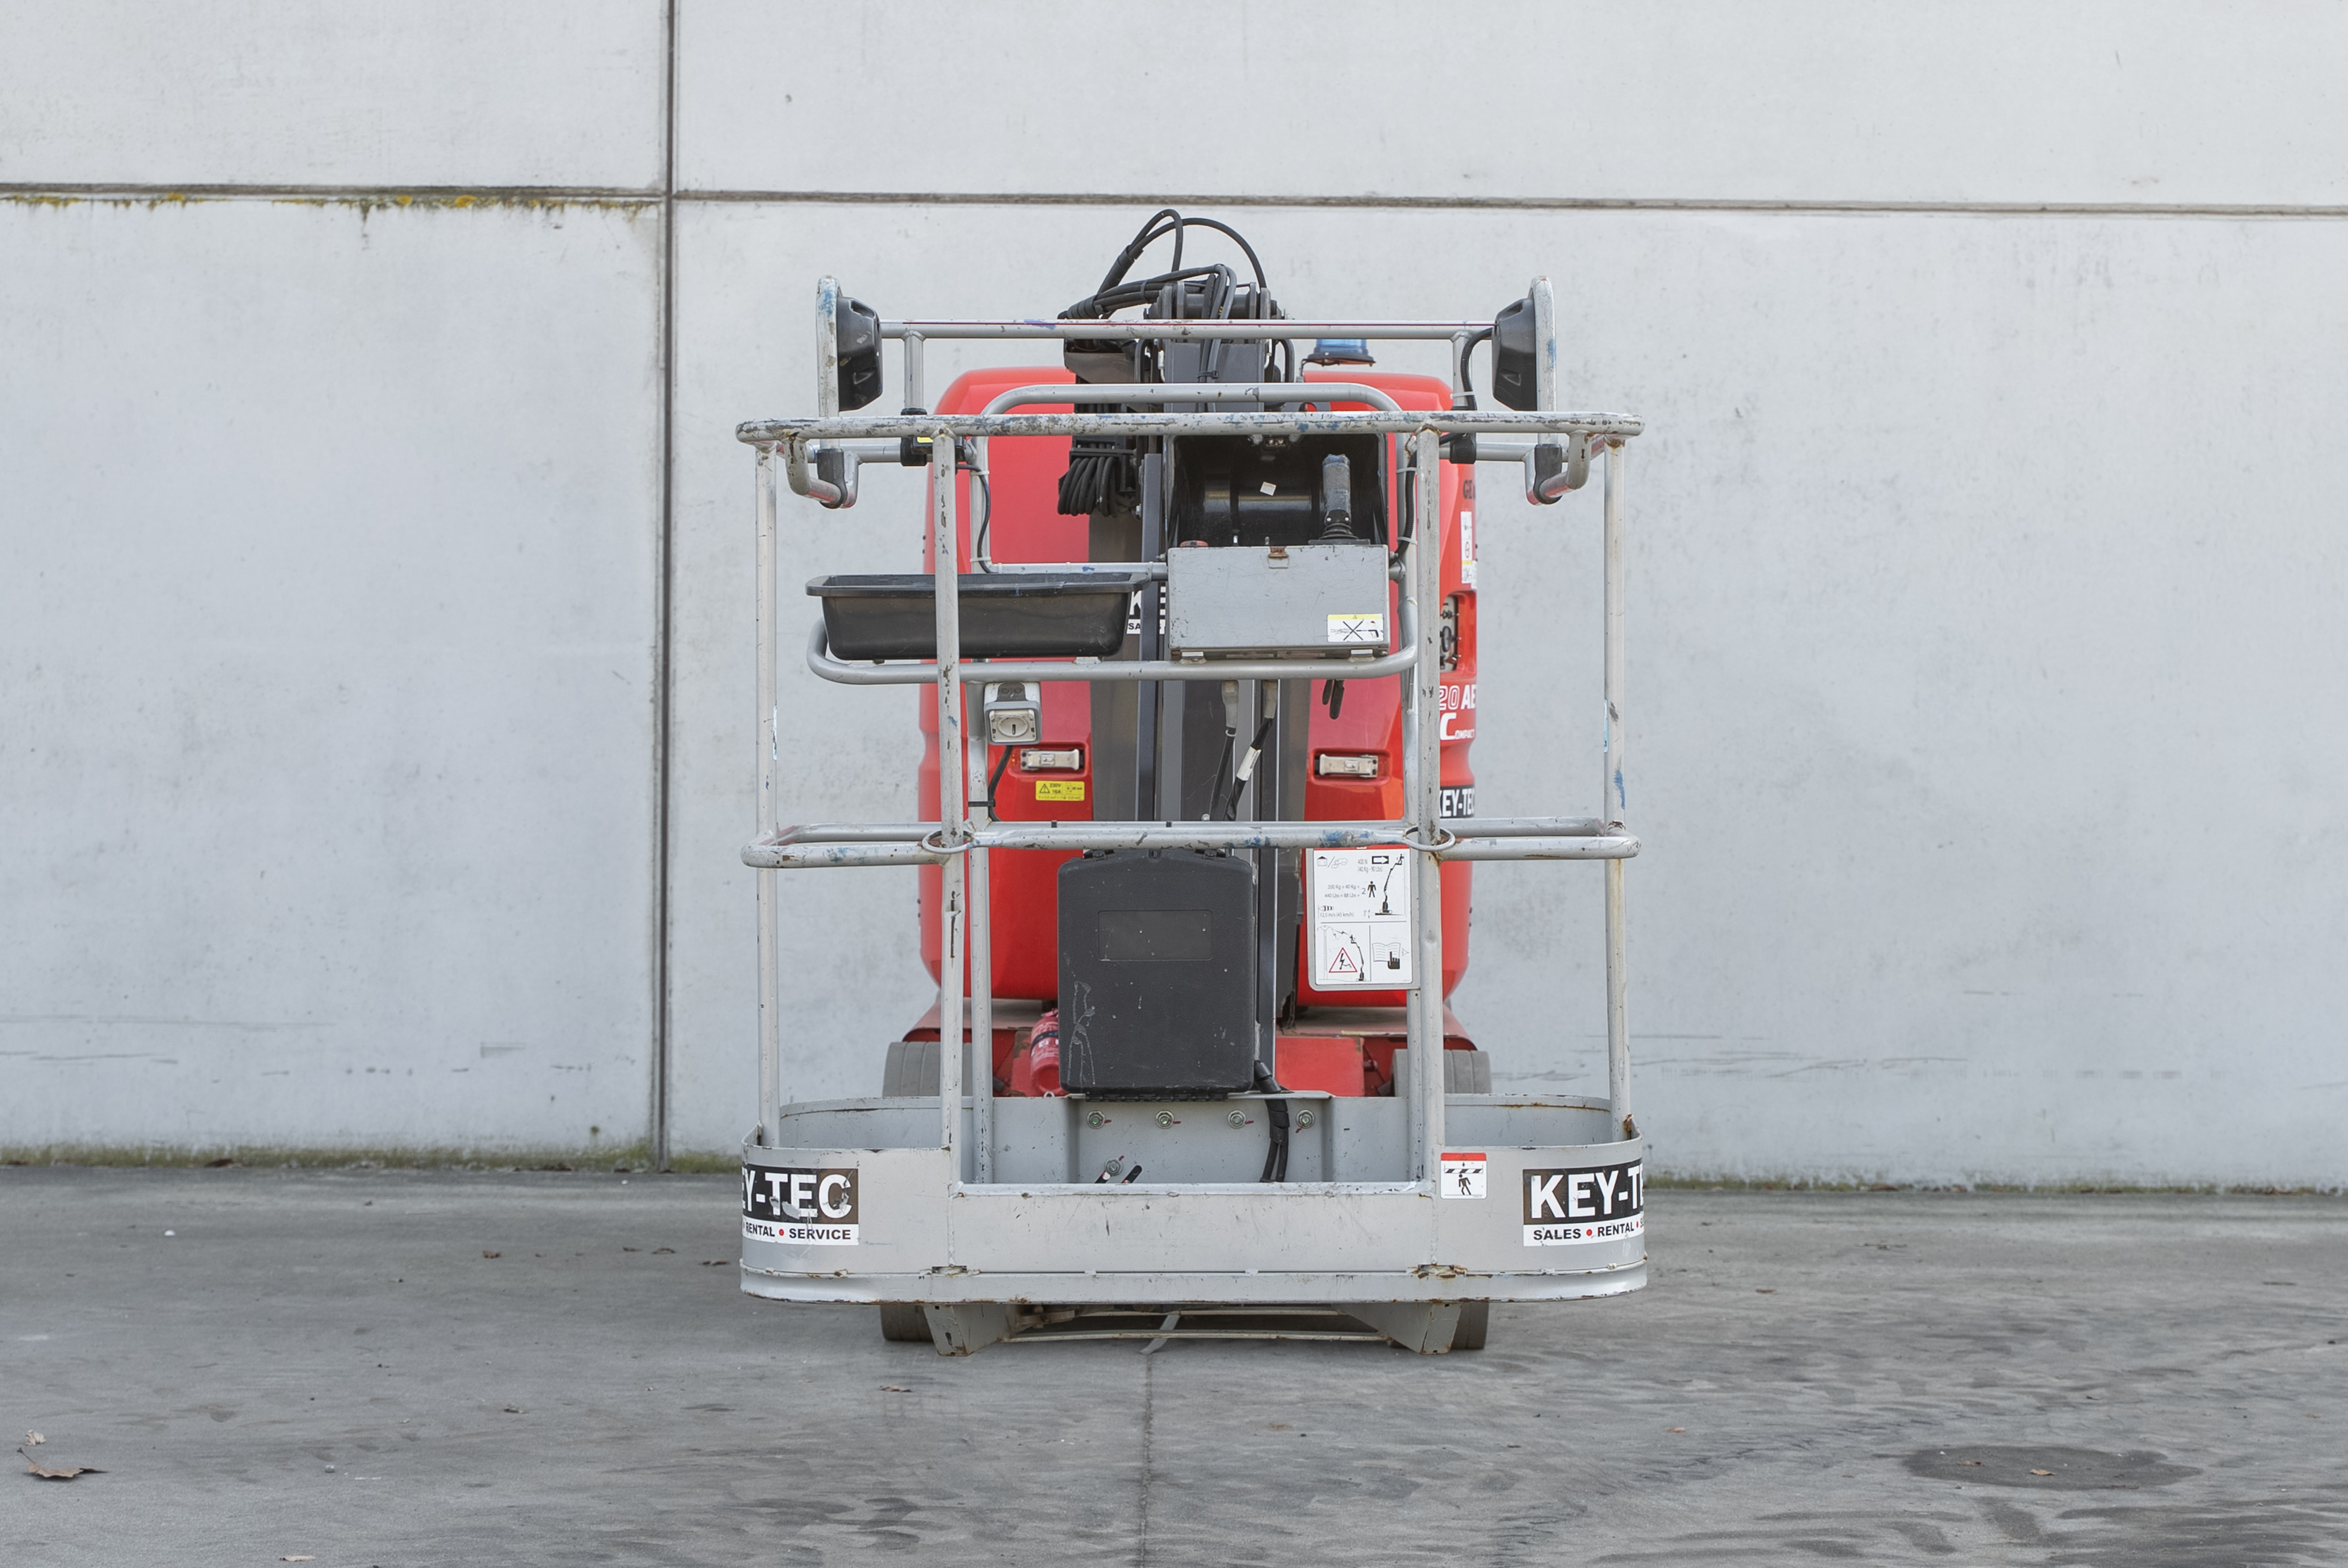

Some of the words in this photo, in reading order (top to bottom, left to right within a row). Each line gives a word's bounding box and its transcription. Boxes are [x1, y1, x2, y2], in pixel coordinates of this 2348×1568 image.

[746, 1222, 775, 1237] RENTAL
[789, 1228, 851, 1240] SERVICE
[1533, 1229, 1581, 1240] SALES
[1597, 1222, 1635, 1236] RENTAL
